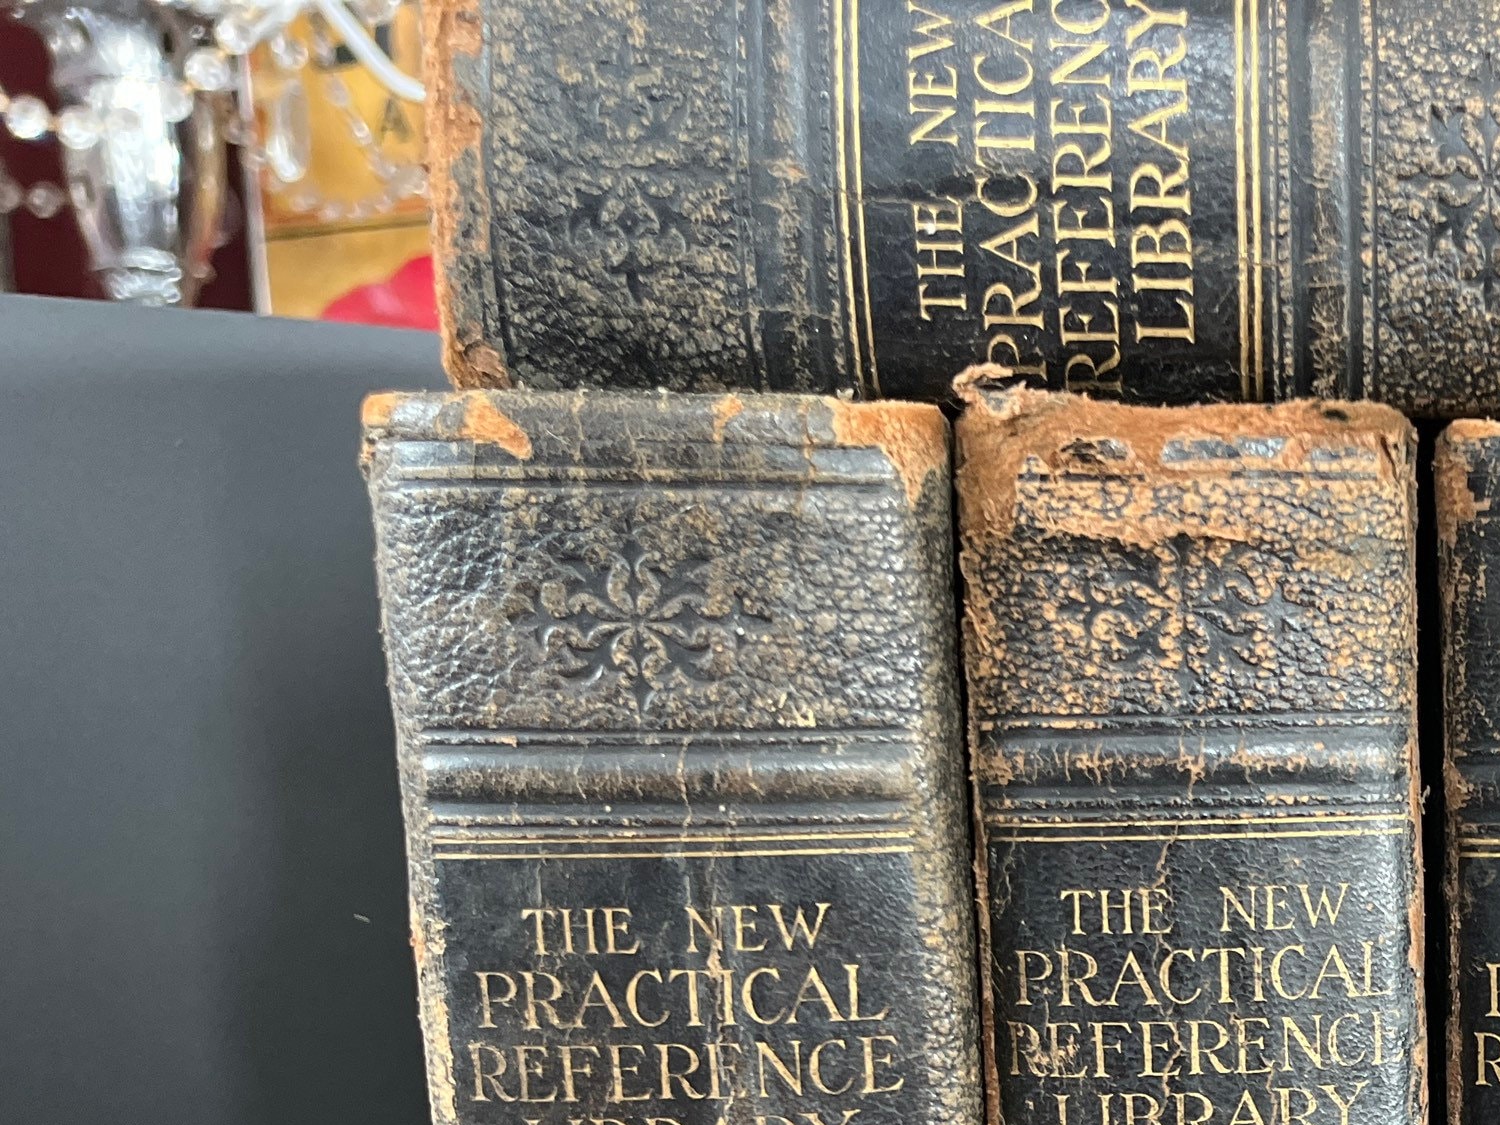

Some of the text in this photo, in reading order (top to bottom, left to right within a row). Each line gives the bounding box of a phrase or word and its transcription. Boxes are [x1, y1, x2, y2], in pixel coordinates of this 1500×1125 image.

[908, 0, 967, 322] THE NEW
[1125, 0, 1195, 344] LIBRARY
[522, 902, 832, 956] THE NEW
[1061, 882, 1349, 935] THE NEW
[474, 963, 890, 1030] PRACTICAL
[1015, 941, 1393, 1007] PRACTICAL
[468, 1035, 905, 1102] REFERENCE
[1007, 1009, 1404, 1078] REFERENCE
